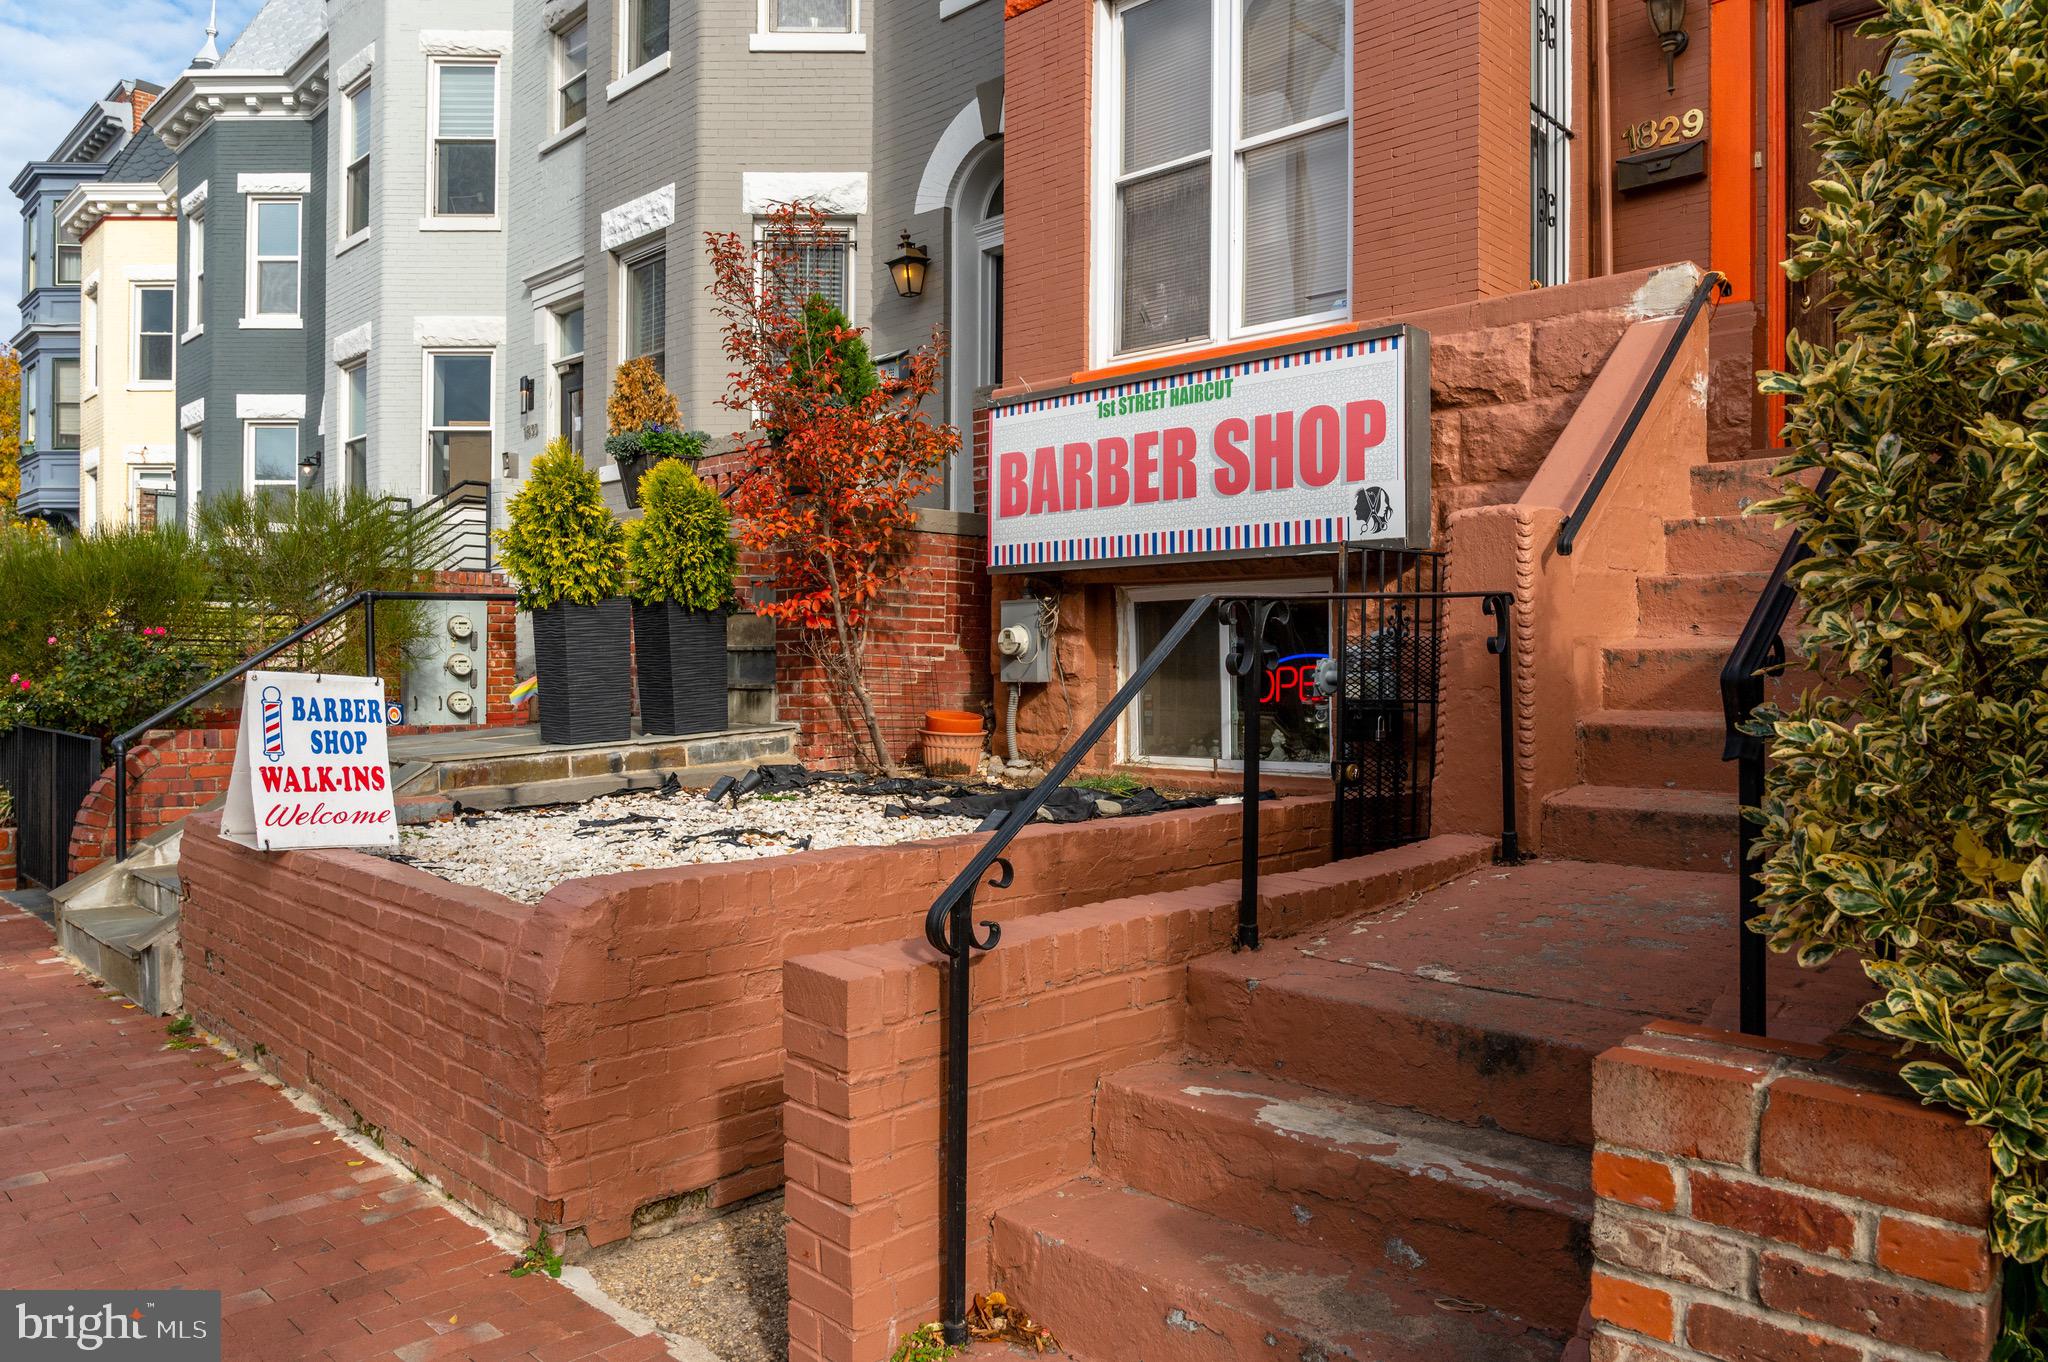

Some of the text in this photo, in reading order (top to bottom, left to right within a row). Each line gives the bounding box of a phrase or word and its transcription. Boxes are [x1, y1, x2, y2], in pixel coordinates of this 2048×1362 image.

[1622, 108, 1704, 153] 1829
[1097, 378, 1234, 418] 1st STREET HAIRCUT
[1000, 399, 1387, 518] BARBER SHOP
[291, 696, 383, 724] BARBER
[310, 729, 367, 755] SHOP
[258, 765, 386, 793] WALK-INS
[264, 802, 391, 828] Welcome
